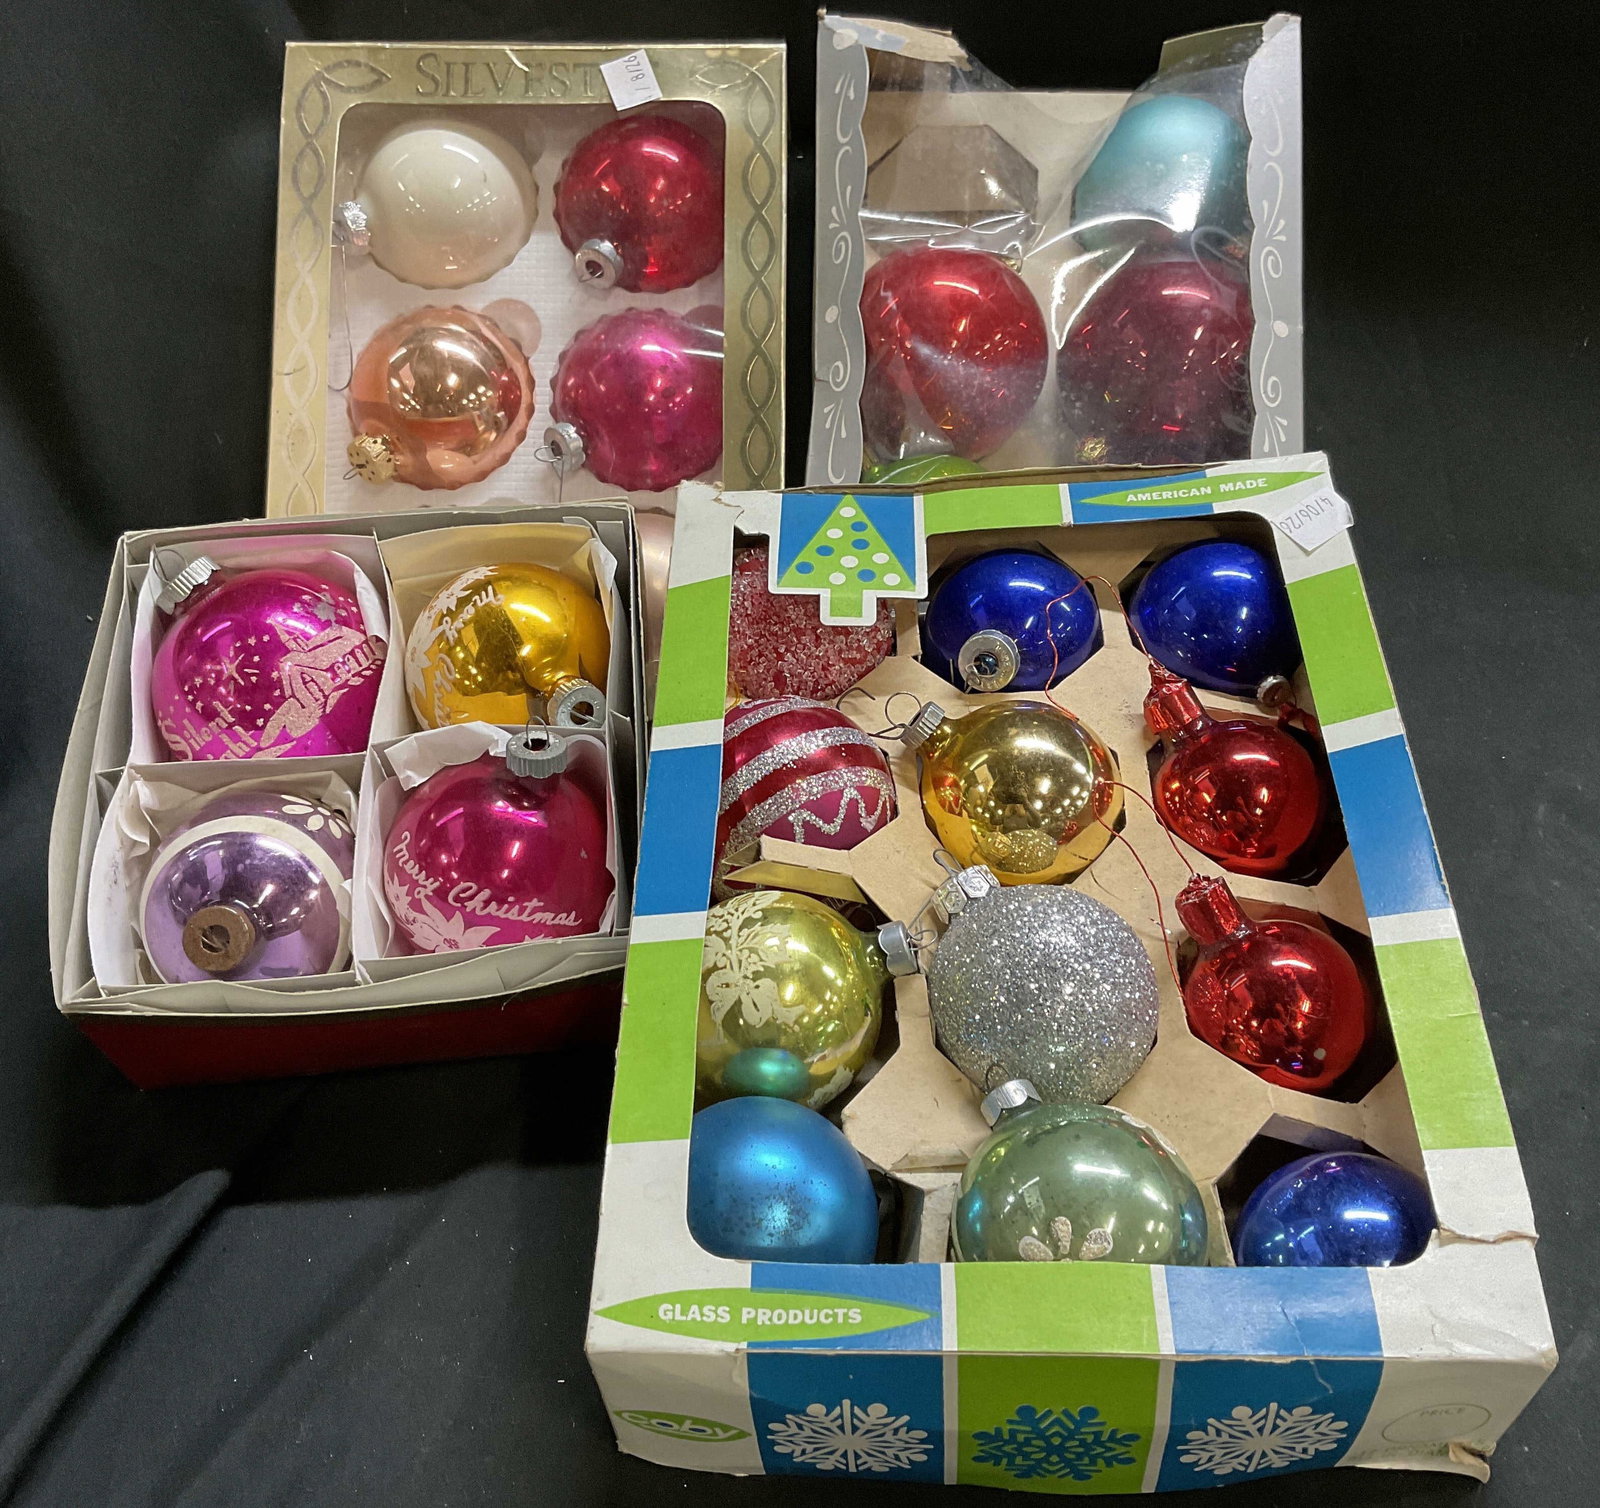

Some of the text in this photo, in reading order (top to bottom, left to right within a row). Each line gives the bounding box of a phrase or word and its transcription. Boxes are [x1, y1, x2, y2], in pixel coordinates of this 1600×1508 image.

[415, 52, 600, 98] SILVEST
[1125, 478, 1269, 503] AMERICAN MADE
[1278, 495, 1335, 534] 4/06/26
[158, 701, 235, 761] Silent
[393, 831, 583, 927] Merry Christmas
[657, 1303, 862, 1326] GLASS PRODUCTS
